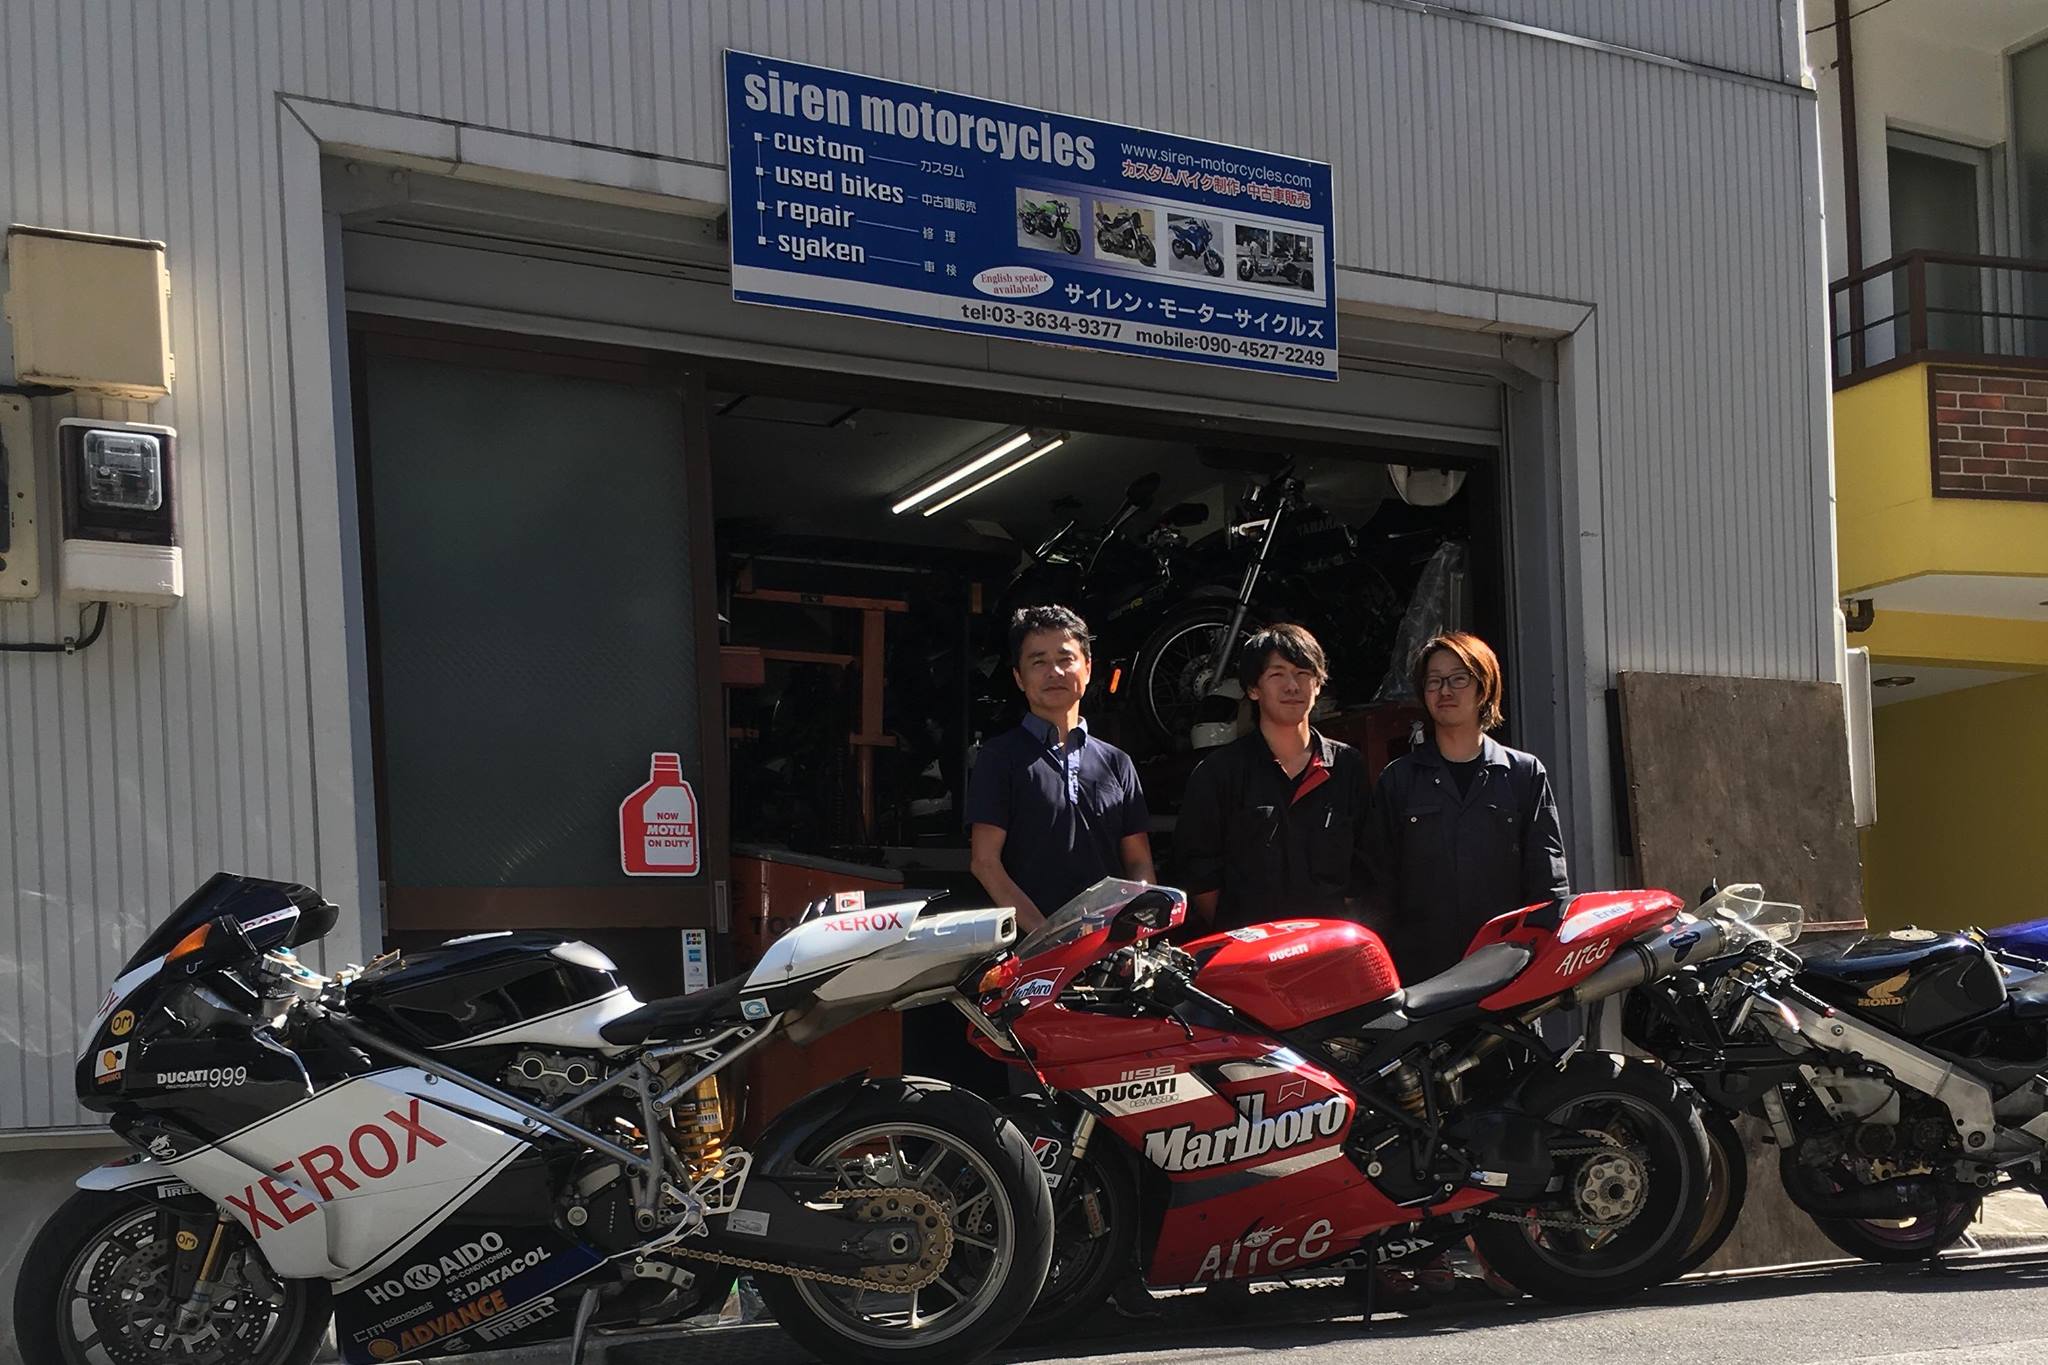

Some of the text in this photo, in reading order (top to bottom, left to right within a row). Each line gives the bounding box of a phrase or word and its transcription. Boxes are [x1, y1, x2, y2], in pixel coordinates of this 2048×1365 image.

[744, 70, 1096, 171] siren motorcycles
[774, 133, 865, 164] custom
[919, 160, 965, 179] カスタム
[1121, 141, 1312, 188] www.siren-motorcycles.com
[775, 166, 904, 204] used bikes
[1122, 159, 1311, 209] カスタムバイク制作・中古車販売
[777, 200, 855, 228] repair
[921, 193, 977, 214] 中古車販売
[778, 234, 865, 264] syaken
[981, 273, 1048, 284] English speaker
[993, 284, 1039, 295] available!
[1065, 283, 1324, 340] サイレン・モーターサイクルズ
[961, 303, 1326, 367] tel:03-3634-9377 mobile:090-4527-2249
[647, 825, 691, 835] MOTUL
[656, 812, 679, 820] NOW
[648, 840, 690, 848] ON DUTY
[825, 911, 904, 932] XEROX
[1268, 943, 1309, 962] DUCATI
[1555, 937, 1611, 977] Alice
[157, 1066, 248, 1088] DUCATI 999
[1121, 1064, 1176, 1081] 1198
[1096, 1077, 1177, 1104] DUCATI
[1144, 1092, 1348, 1172] Marlboro
[225, 1099, 448, 1239] XEROX
[1194, 1218, 1334, 1282] Alice
[364, 1232, 503, 1305] HOKKAIDO
[467, 1246, 551, 1297] DATACOL
[400, 1290, 509, 1350] ADVANCE
[475, 1296, 560, 1342] PIRELLI
